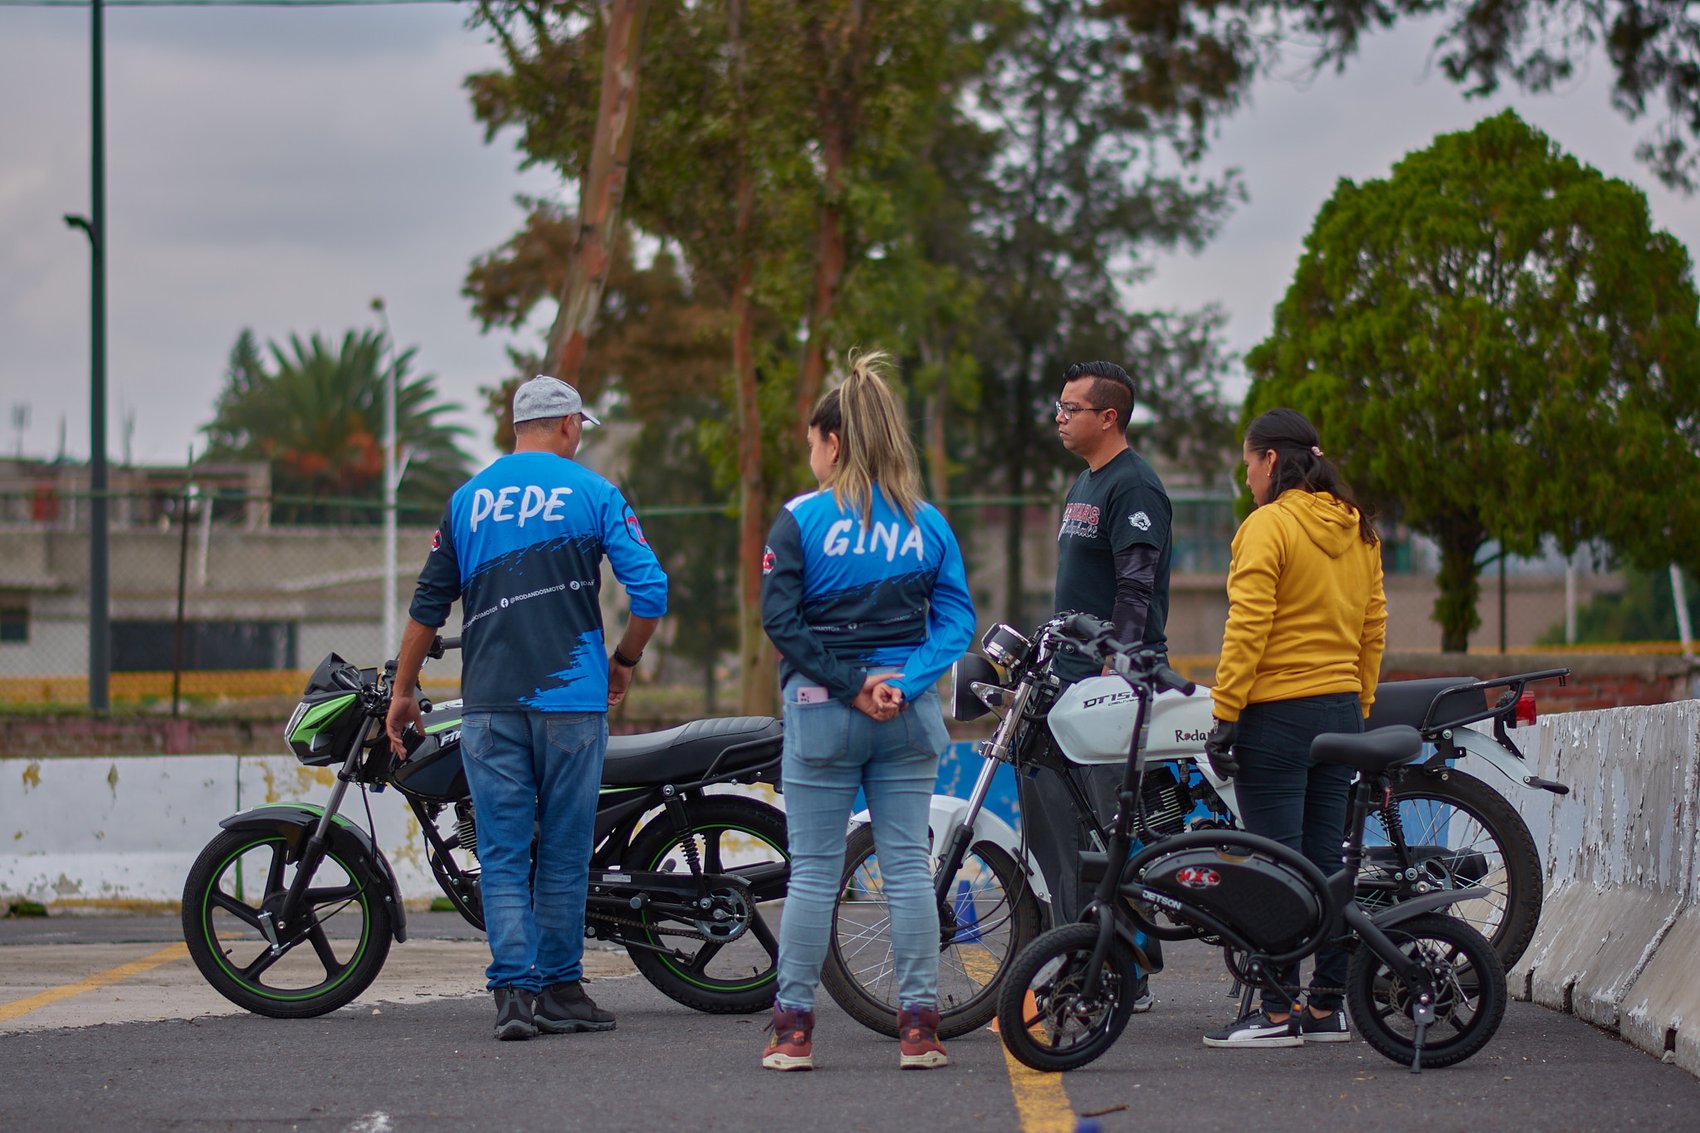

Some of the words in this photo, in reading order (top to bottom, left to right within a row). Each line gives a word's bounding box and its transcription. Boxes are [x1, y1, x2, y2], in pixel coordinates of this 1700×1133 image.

[470, 485, 573, 533] PEPE
[823, 519, 924, 562] GINA
[509, 583, 566, 604] @RODANDOSMOTOS
[1142, 889, 1183, 911] JETSON
